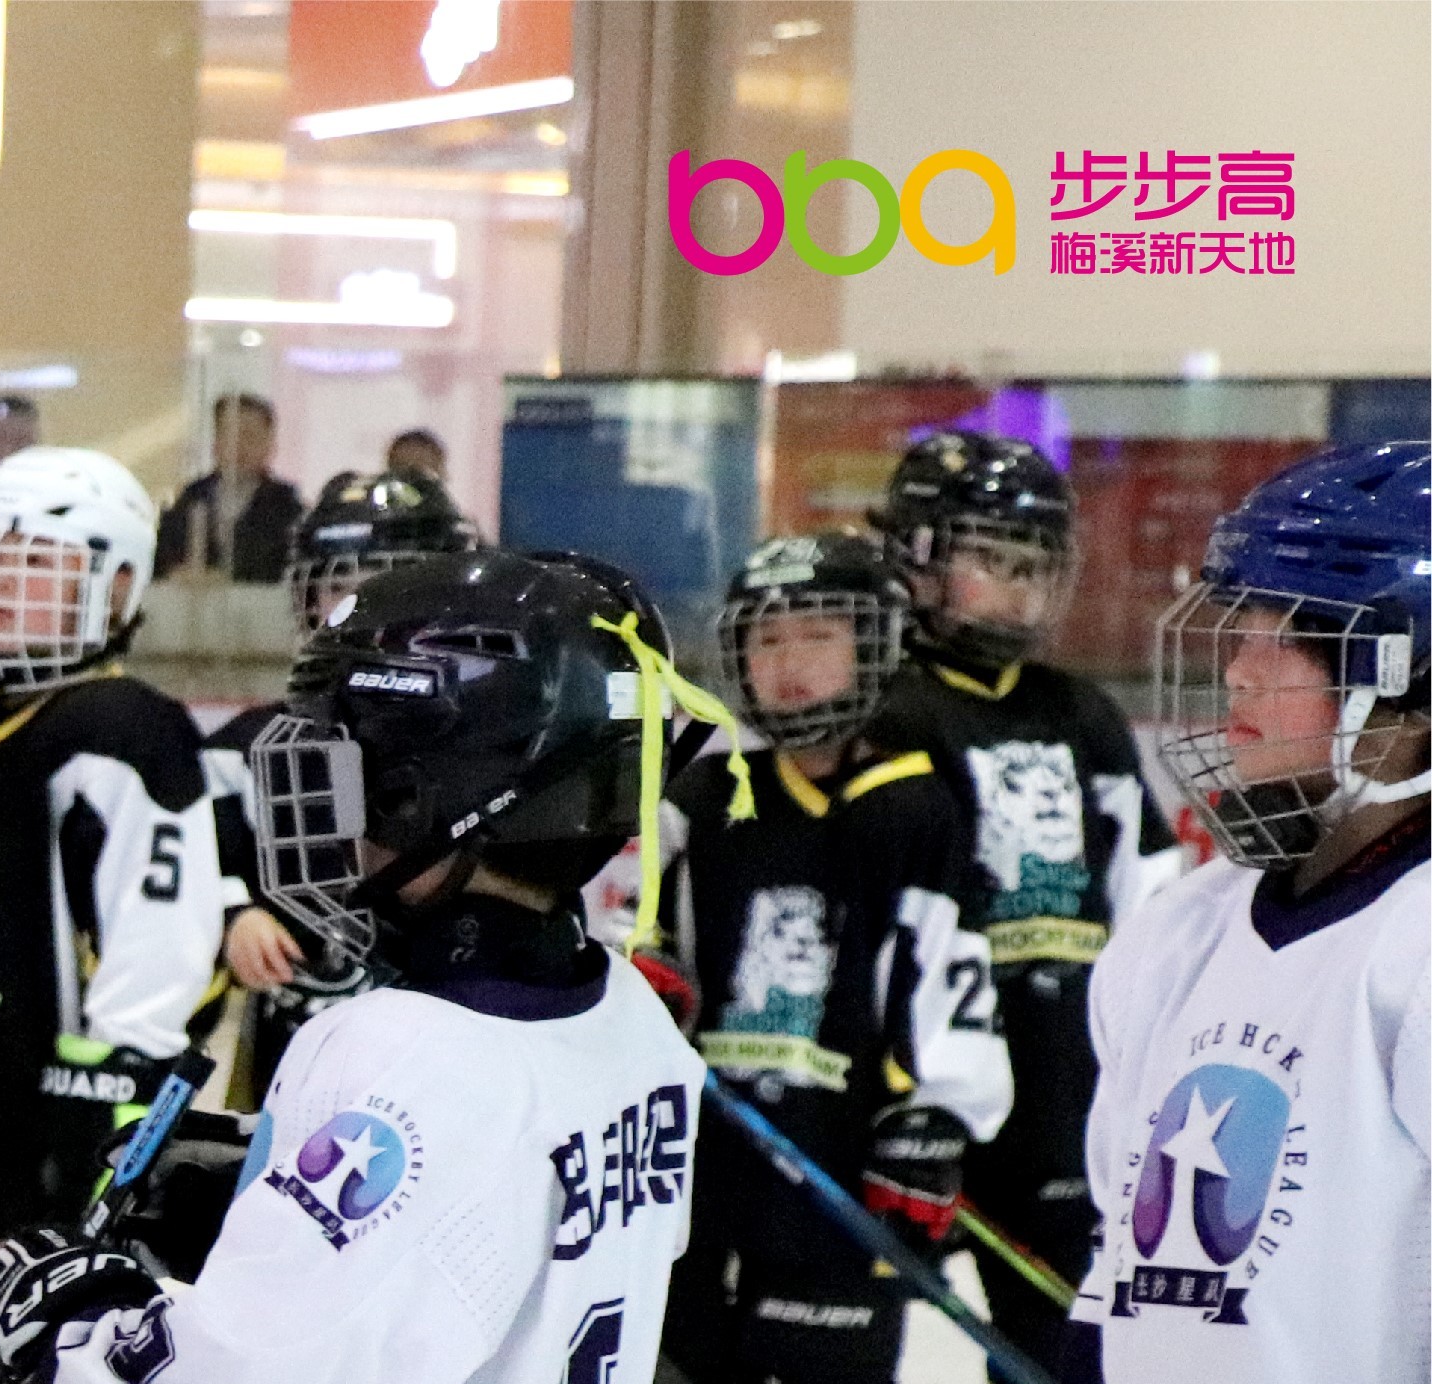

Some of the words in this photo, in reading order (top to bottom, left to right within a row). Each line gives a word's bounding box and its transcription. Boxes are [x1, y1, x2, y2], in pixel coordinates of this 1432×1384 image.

[348, 671, 431, 693] BAUER
[450, 789, 518, 840] BAER
[140, 823, 184, 902] 5
